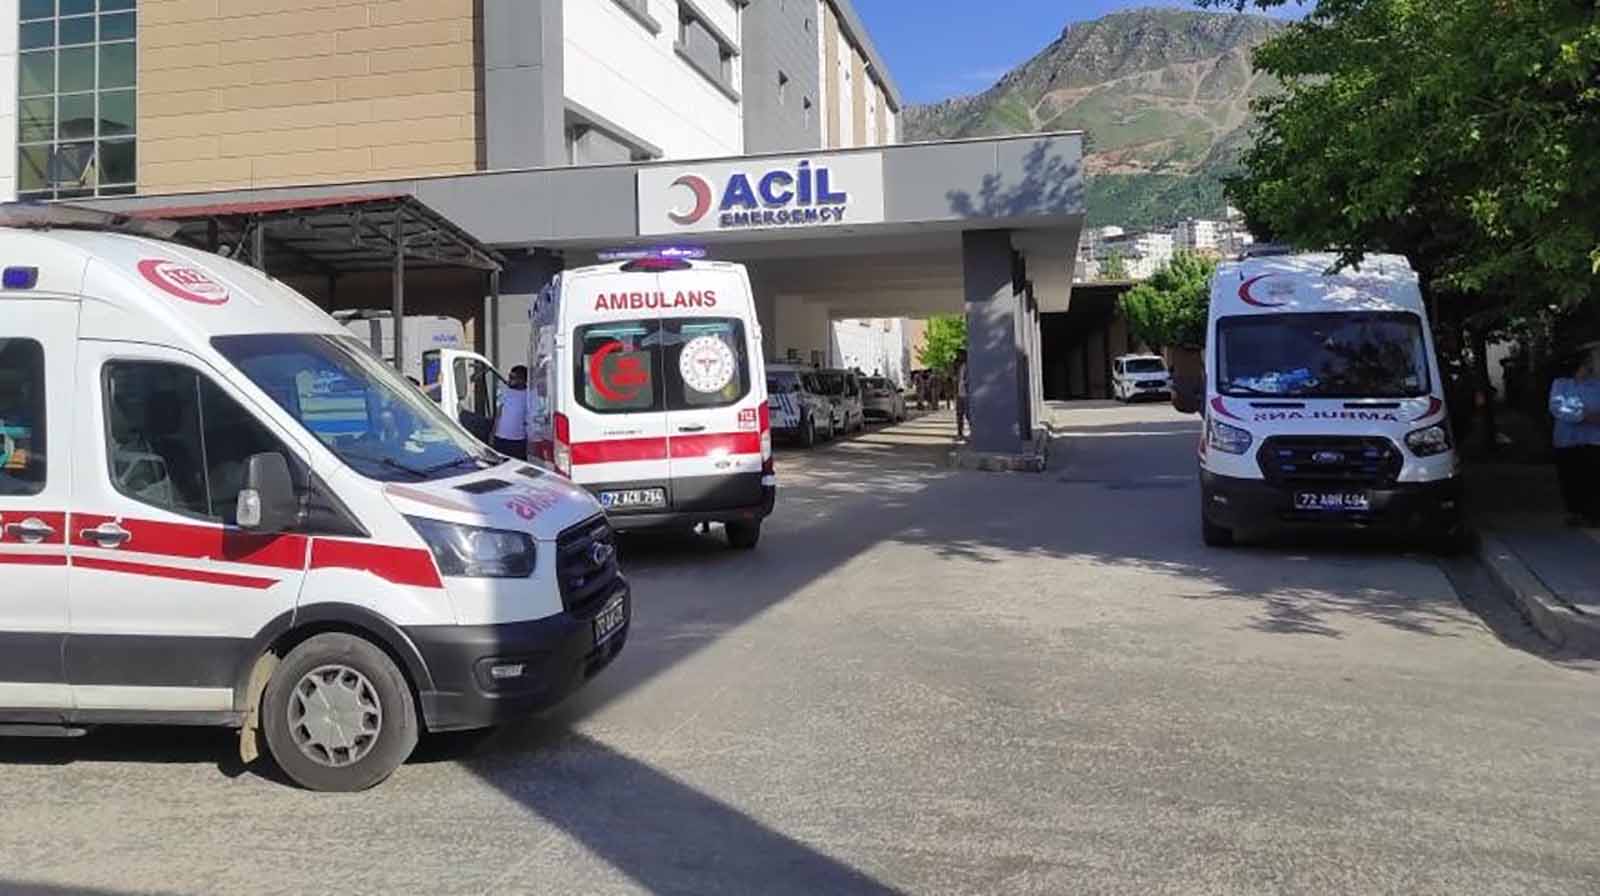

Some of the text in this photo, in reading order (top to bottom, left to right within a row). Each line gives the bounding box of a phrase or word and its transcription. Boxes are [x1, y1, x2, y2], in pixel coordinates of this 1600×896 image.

[719, 160, 847, 209] ACİL
[719, 207, 847, 227] EMERGENCY
[595, 290, 717, 310] AMBULANS
[1301, 493, 1317, 505] 72
